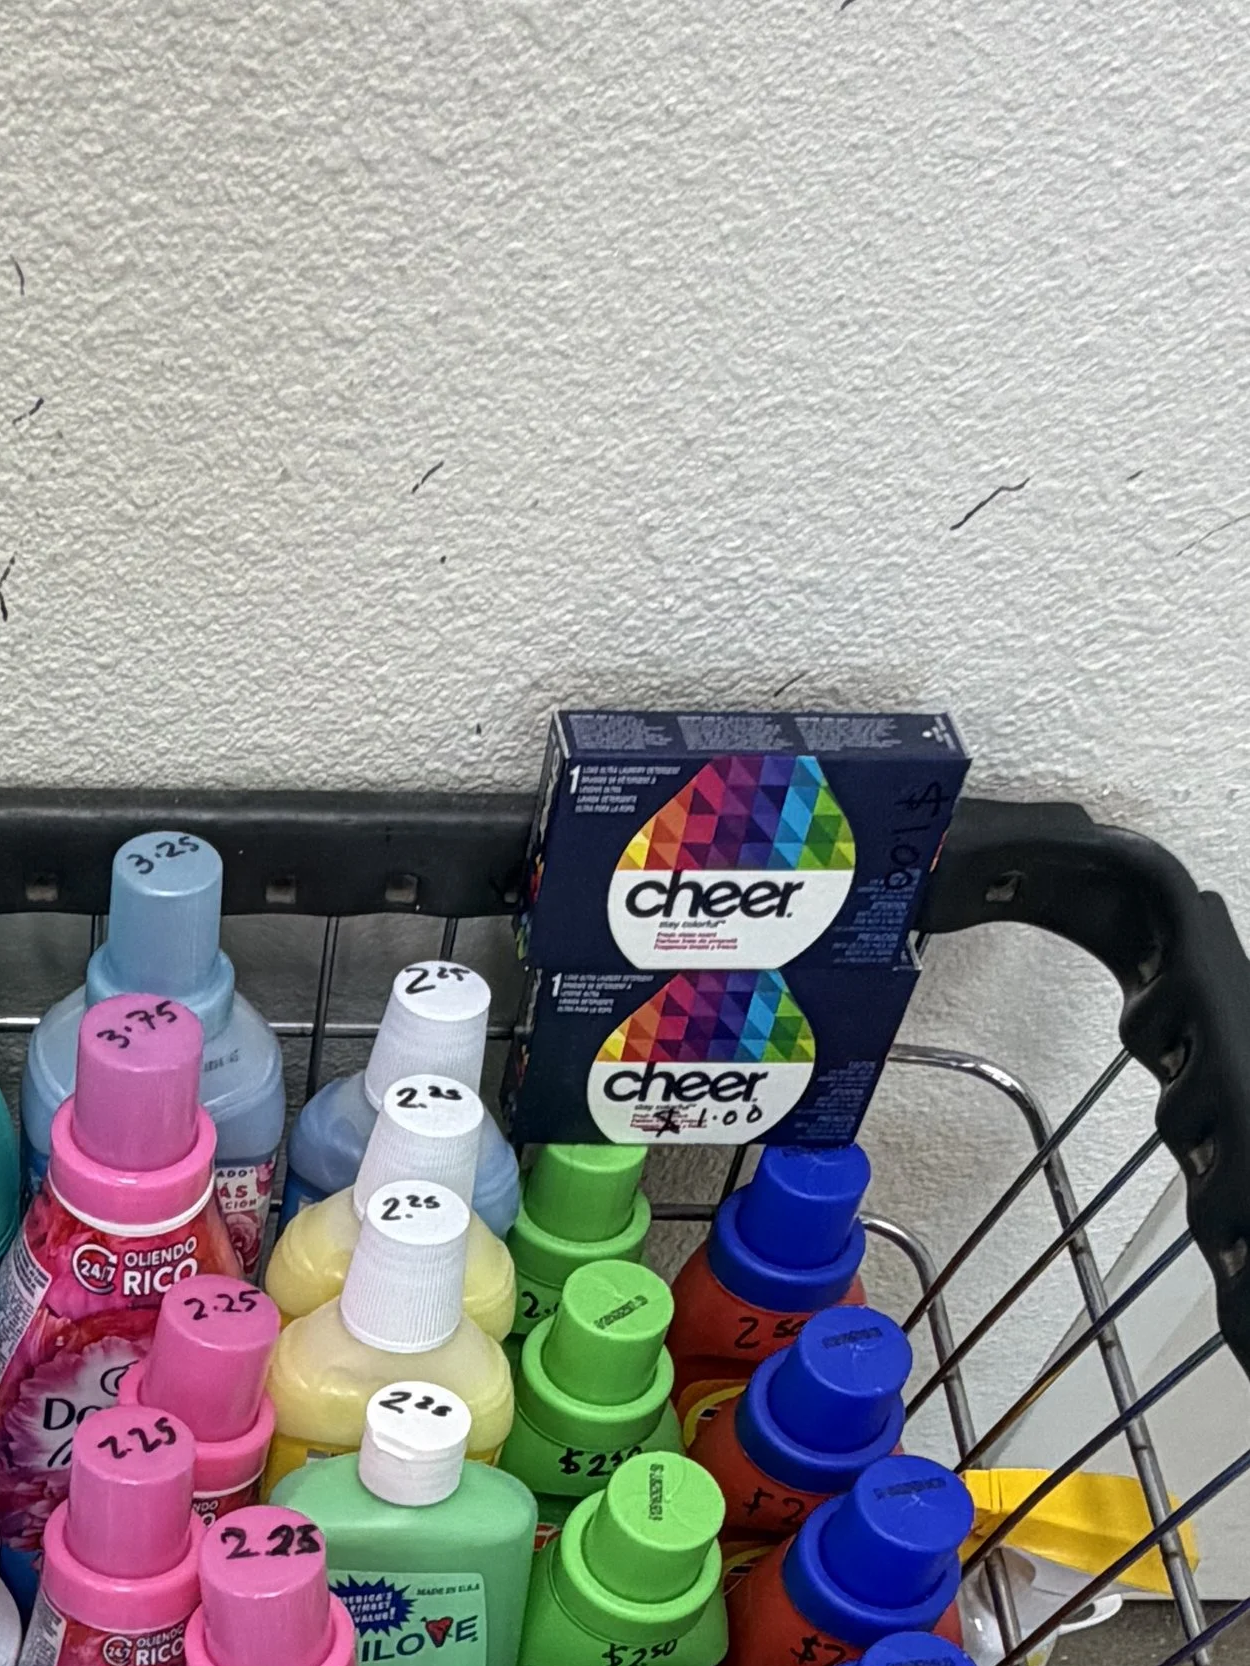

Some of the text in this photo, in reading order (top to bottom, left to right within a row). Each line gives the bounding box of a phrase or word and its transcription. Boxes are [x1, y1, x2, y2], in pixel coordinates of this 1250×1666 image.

[569, 765, 582, 793] 1
[127, 836, 200, 875] 3.25
[552, 974, 562, 997] 1
[97, 1001, 179, 1050] 3.75
[218, 1182, 249, 1199] ÁS
[80, 1236, 198, 1283] 24/7 OLIENDO
[123, 1258, 198, 1296] RICO
[183, 1290, 262, 1321] 2.25
[342, 1591, 394, 1606] ERICA'S
[136, 1622, 185, 1648] OLIENDO
[135, 1636, 185, 1666] RICO
